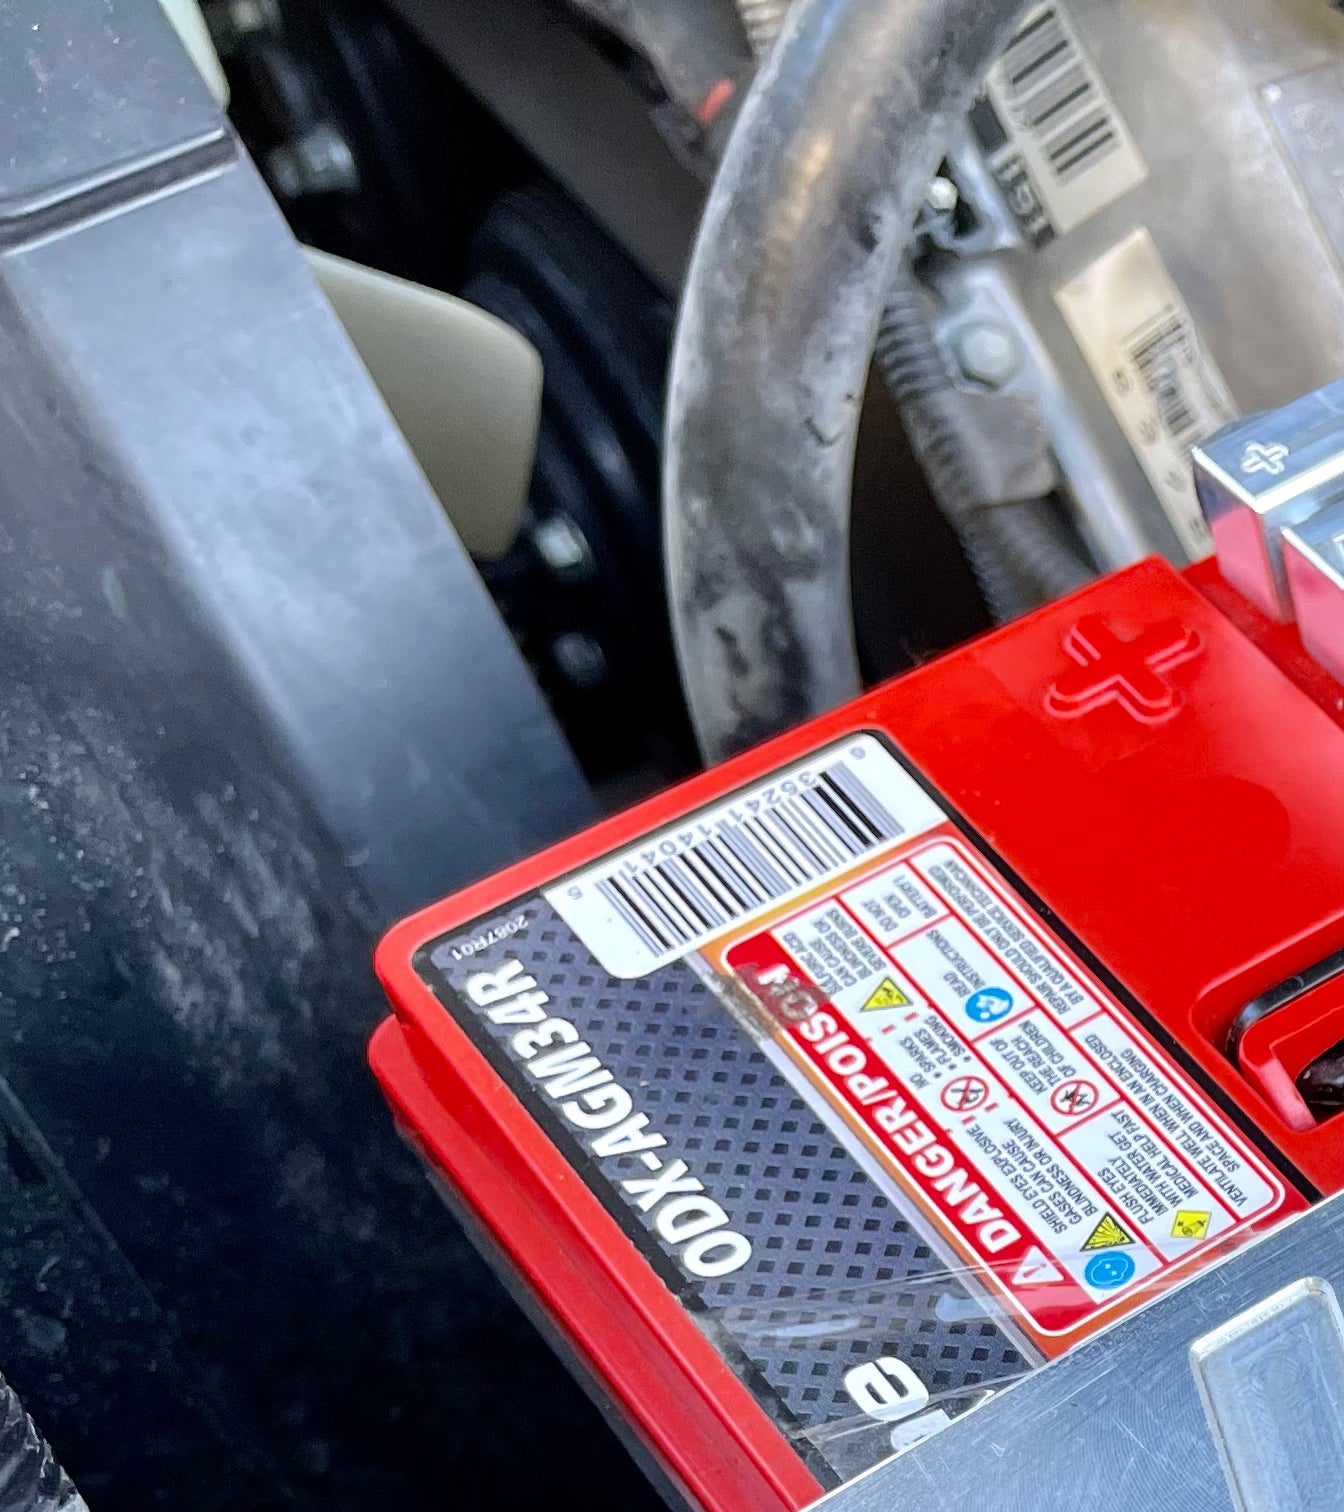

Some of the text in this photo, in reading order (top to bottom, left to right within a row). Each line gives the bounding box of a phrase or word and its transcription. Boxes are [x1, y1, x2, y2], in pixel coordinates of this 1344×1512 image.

[448, 913, 532, 960] 2087R01
[925, 928, 986, 990] INSTRUCTIONS
[941, 970, 972, 998] READ
[898, 1035, 937, 1073] SPARKS
[912, 1026, 952, 1066] FLAMES
[923, 1014, 966, 1057] SMOKING
[1009, 1034, 1062, 1088] THE REACH
[1017, 1018, 1077, 1079] OF CHILDREN
[908, 1071, 930, 1090] NO
[988, 1037, 1048, 1096] KEEP OUT OF
[466, 961, 750, 1276] ODX-AGM34R
[754, 962, 1024, 1252] DANGER/POISON
[1083, 1032, 1248, 1207] VENTILATE WELL WHEN IN AN ENCLOSED
[1119, 1047, 1241, 1173] SPACE AND WHEN CHARGING
[965, 1123, 1068, 1235] SHIELD EYES EXPLOSIVE
[1000, 1138, 1083, 1225] GASES CAN CAUSE
[1002, 1117, 1099, 1217] BLINDNESS OR INJURY
[1106, 1129, 1184, 1208] WITH WATER GET
[1109, 1108, 1199, 1199] MEDICAL HELP FAST
[1095, 1165, 1155, 1226] FLUSH EYES
[1107, 1155, 1169, 1216] IMMEDIATELY
